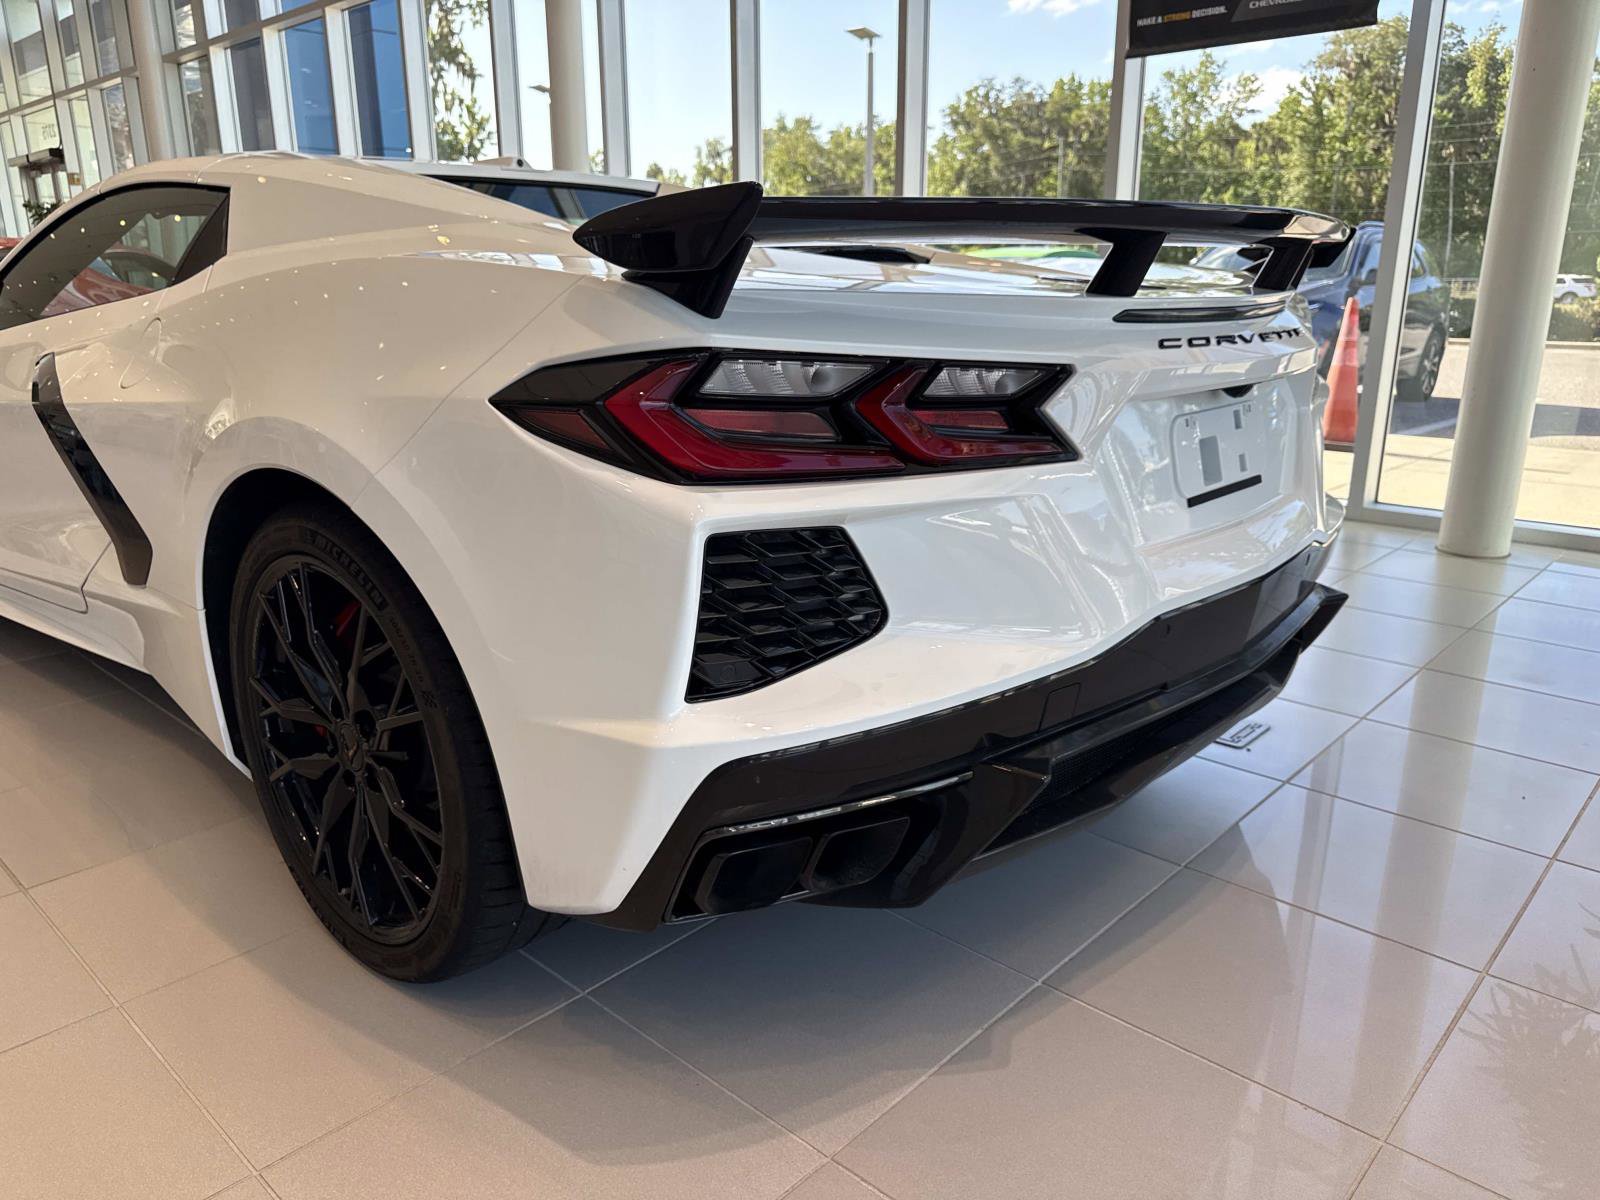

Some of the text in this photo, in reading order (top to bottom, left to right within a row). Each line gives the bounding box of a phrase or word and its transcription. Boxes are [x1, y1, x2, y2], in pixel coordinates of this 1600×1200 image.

[1137, 16, 1156, 27] MAKE
[1157, 15, 1163, 23] A
[313, 532, 386, 609] MICHELIN
